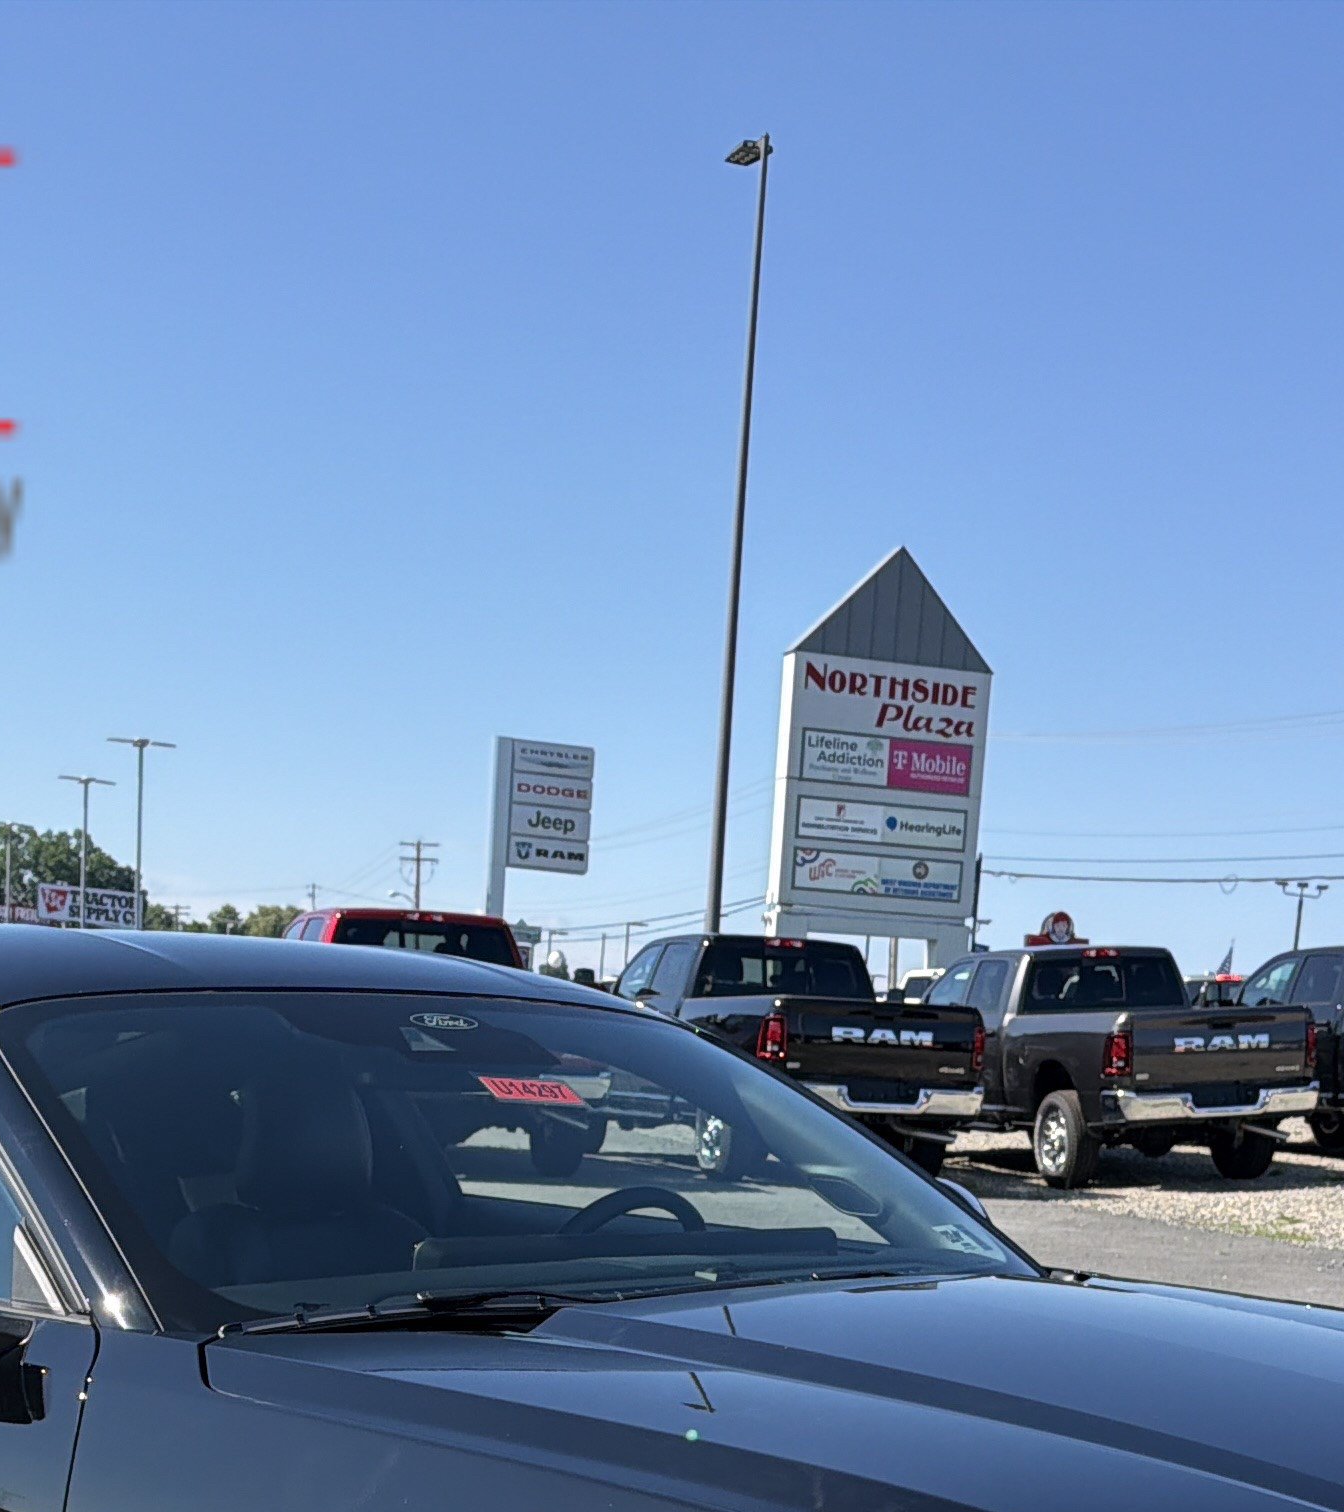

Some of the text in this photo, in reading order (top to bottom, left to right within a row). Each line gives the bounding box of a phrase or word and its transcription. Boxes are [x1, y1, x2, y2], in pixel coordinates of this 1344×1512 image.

[804, 660, 978, 709] NORTHSIDE
[875, 702, 975, 738] Plaza
[807, 735, 858, 752] Lifeline
[817, 750, 885, 768] Addiction
[911, 752, 966, 776] Mobile
[516, 782, 588, 799] DODGE
[526, 810, 576, 835] Jeep
[899, 820, 962, 838] HearingLife
[535, 848, 586, 862] RAM
[831, 1026, 934, 1046] RAM
[1173, 1032, 1270, 1052] RAM
[489, 1079, 568, 1100] U14297
